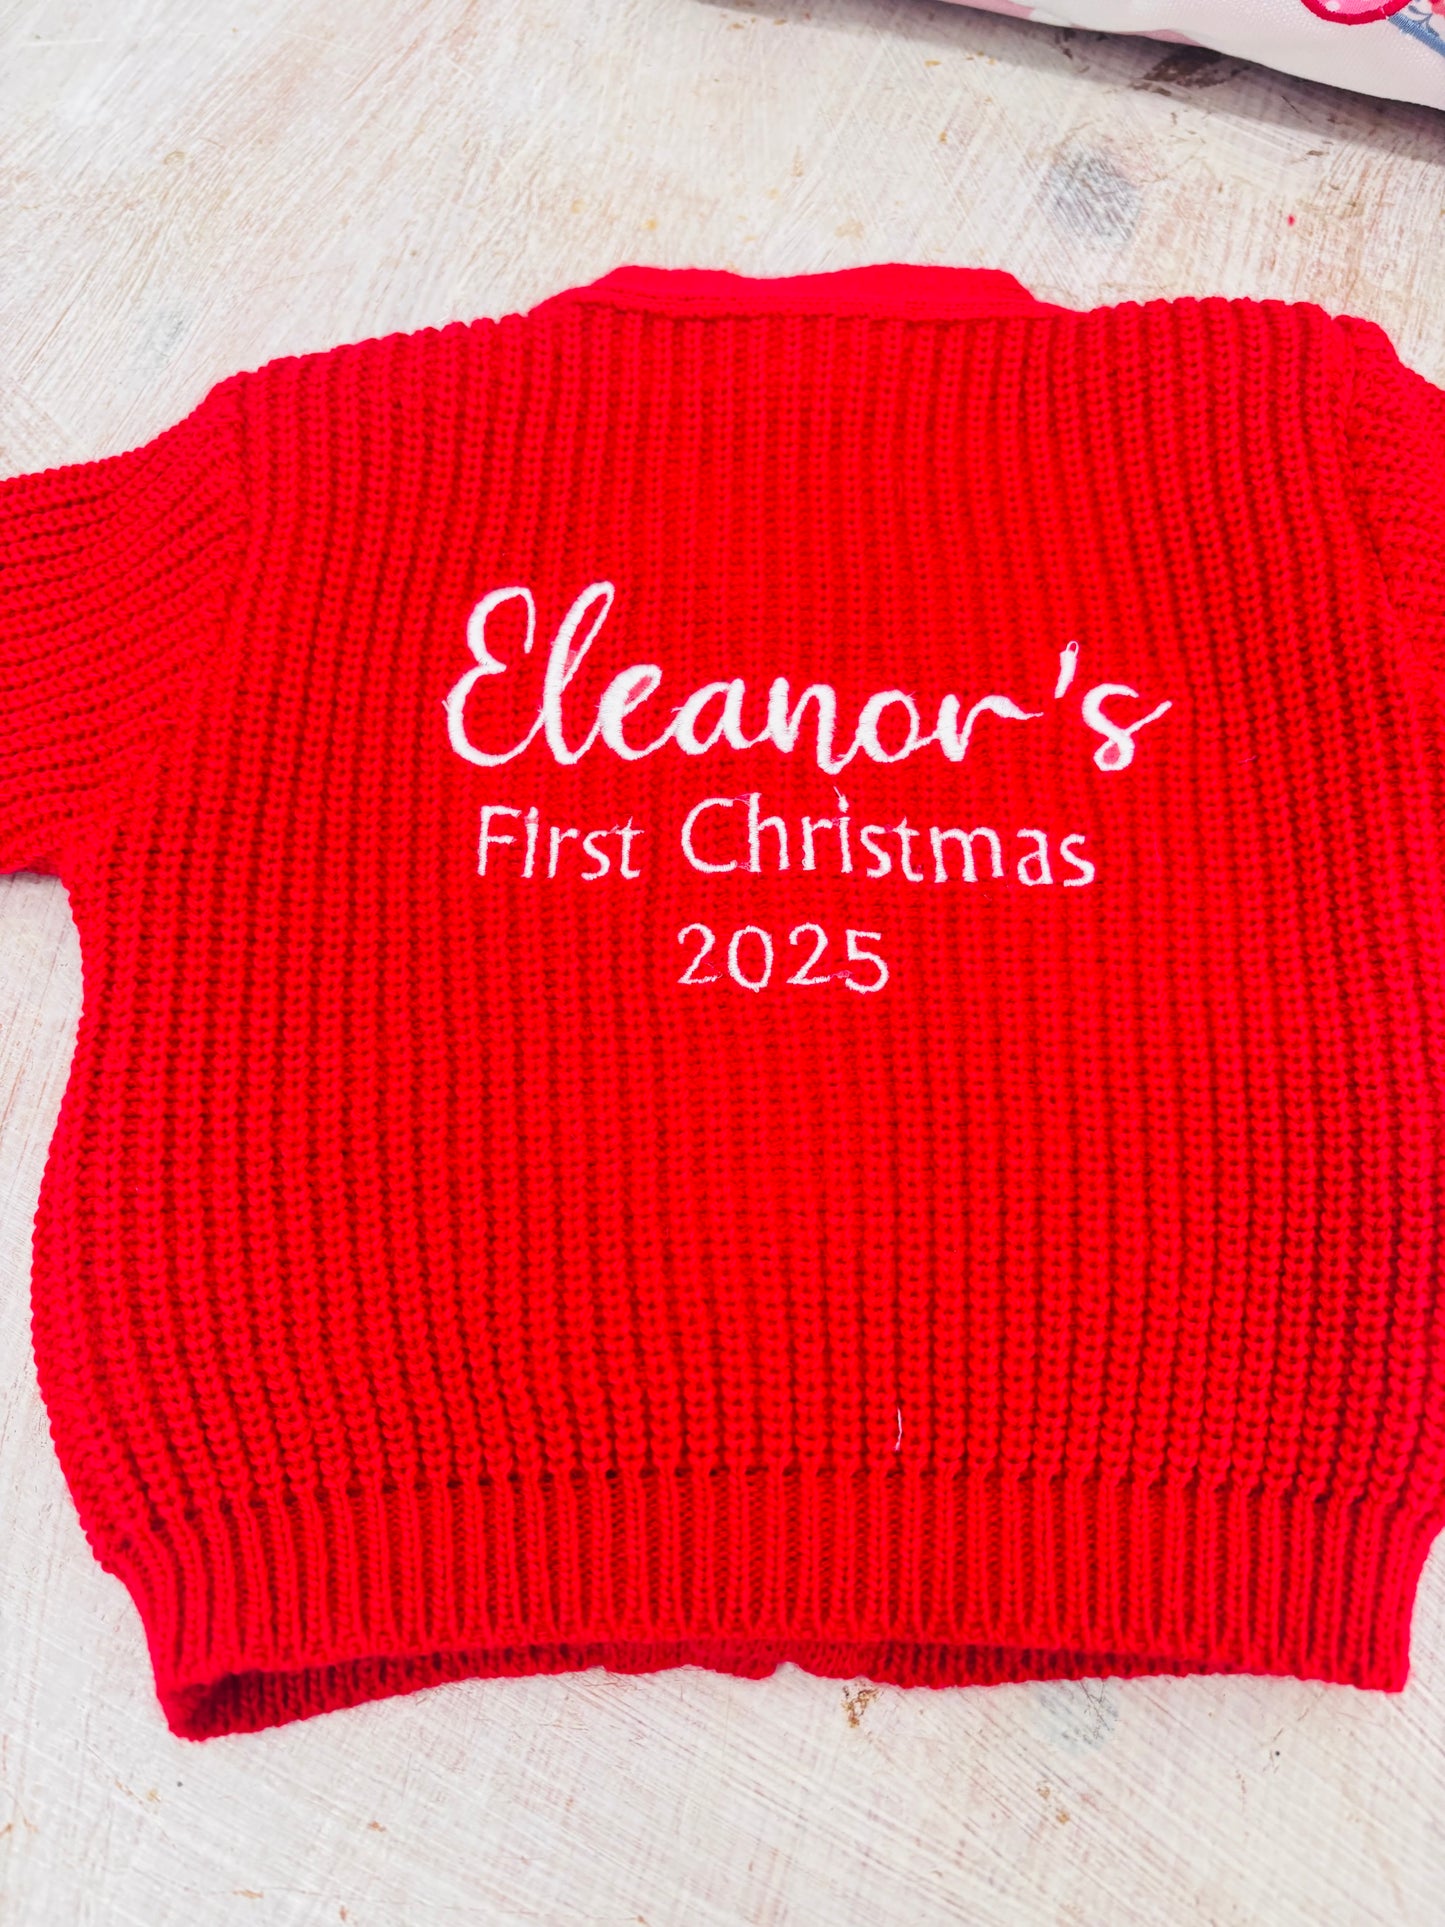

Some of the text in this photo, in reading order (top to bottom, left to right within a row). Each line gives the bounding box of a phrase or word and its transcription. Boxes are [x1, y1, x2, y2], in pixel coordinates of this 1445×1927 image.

[442, 581, 1172, 774] Eleanor's
[476, 790, 1095, 887] First Christmas
[677, 922, 890, 993] 2025
